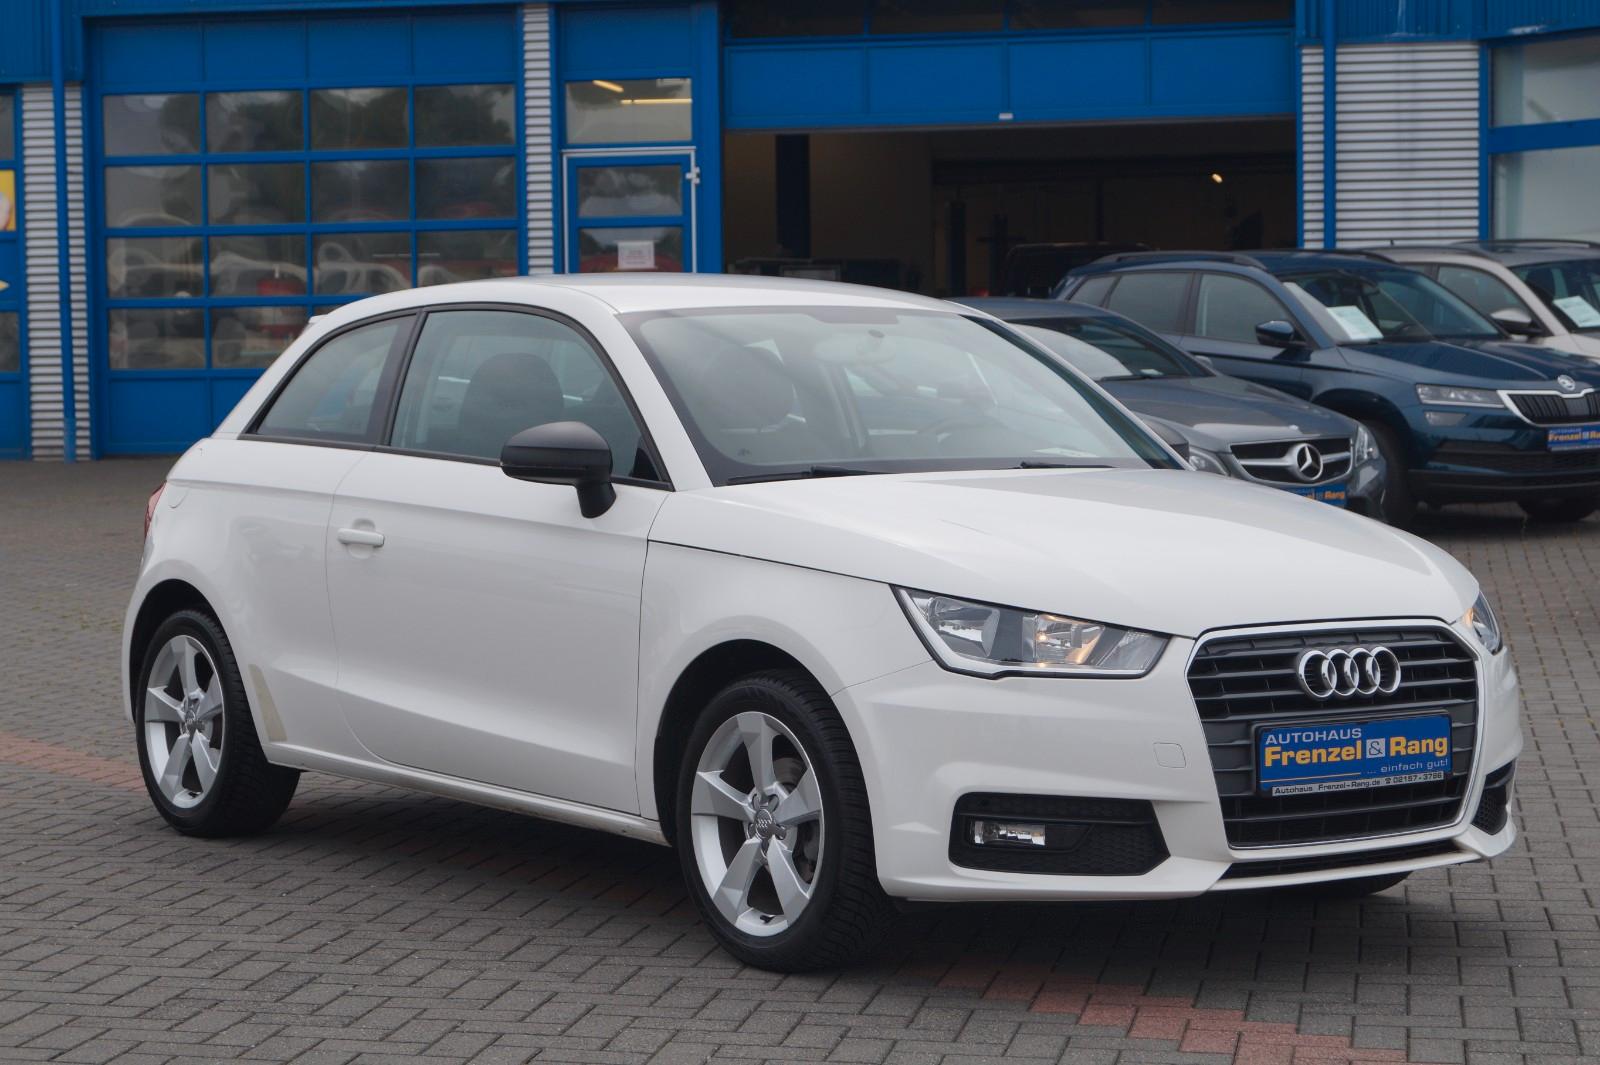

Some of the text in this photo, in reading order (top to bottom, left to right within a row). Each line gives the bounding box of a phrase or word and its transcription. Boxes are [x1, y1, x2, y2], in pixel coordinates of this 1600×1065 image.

[1265, 727, 1362, 745] AUTOHAUS
[1264, 736, 1448, 767] Frenzel & Rang
[1380, 761, 1423, 773] einfach
[1426, 758, 1448, 770] gut!
[1274, 785, 1313, 794] Autohaus
